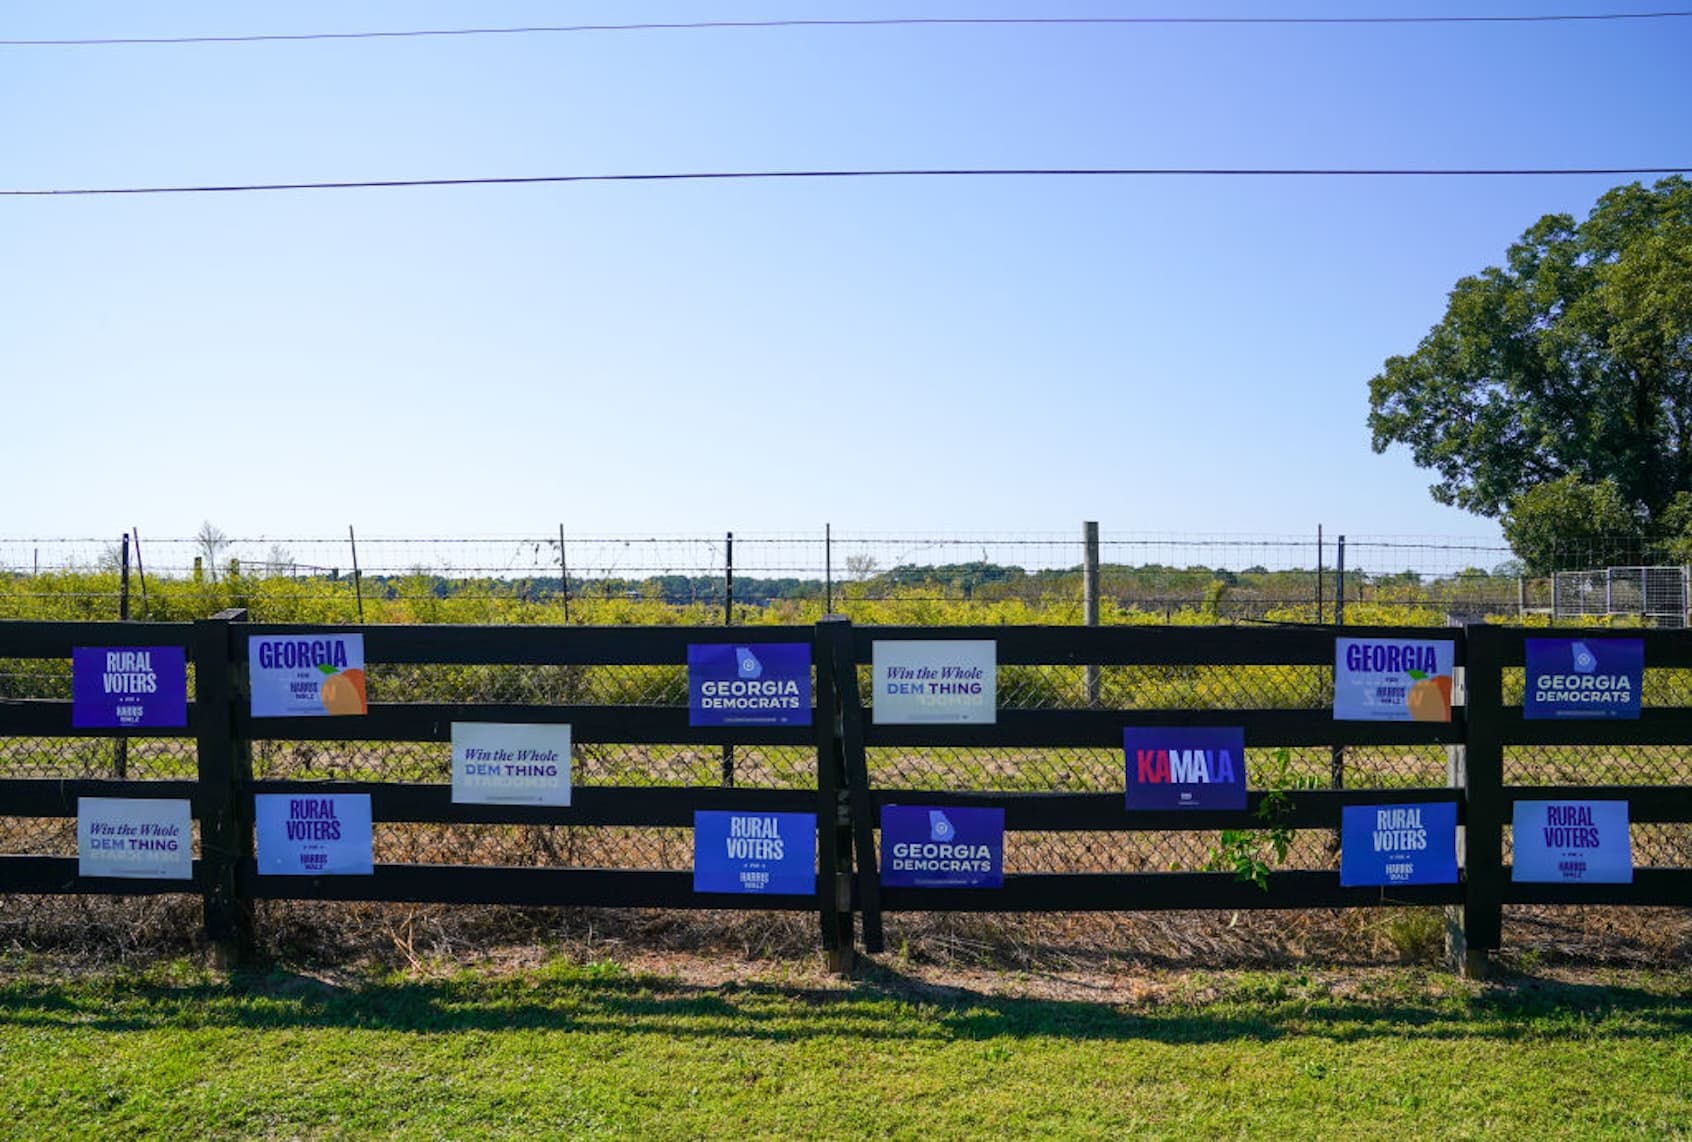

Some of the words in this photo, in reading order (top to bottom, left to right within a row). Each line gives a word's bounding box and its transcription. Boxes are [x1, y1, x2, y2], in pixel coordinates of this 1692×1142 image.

[106, 651, 153, 673] RURAL
[259, 640, 348, 669] GEORGIA
[1346, 644, 1437, 673] GEORGIA
[103, 672, 157, 694] VOTERS
[887, 666, 914, 680] Win
[916, 666, 938, 680] the
[942, 666, 984, 680] Whole
[1537, 675, 1631, 690] GEORGIA
[701, 680, 799, 696] GEORGIA
[887, 683, 924, 694] DEM
[928, 683, 982, 694] THING
[1535, 691, 1631, 702] DEMOCRATS
[701, 697, 799, 709] DEMOCRATS
[465, 748, 491, 761] Win
[493, 749, 514, 761] the
[517, 749, 559, 761] Whole
[465, 764, 500, 776] DEM
[504, 765, 558, 777] THING
[1136, 749, 1235, 784] KAMALA
[290, 799, 337, 820] RURAL
[1377, 808, 1424, 830] RURAL
[1547, 806, 1595, 826] RURAL
[89, 823, 115, 835] Win
[117, 824, 138, 836] the
[140, 824, 180, 836] Whole
[286, 820, 341, 841] VOTERS
[730, 816, 781, 839] RURAL
[1544, 827, 1600, 848] VOTERS
[90, 839, 125, 850] DEM
[128, 839, 178, 851] THING
[726, 838, 784, 860] VOTERS
[1373, 829, 1427, 852] VOTERS
[893, 843, 991, 859] GEORGIA
[893, 859, 991, 872] DEMOCRATS
